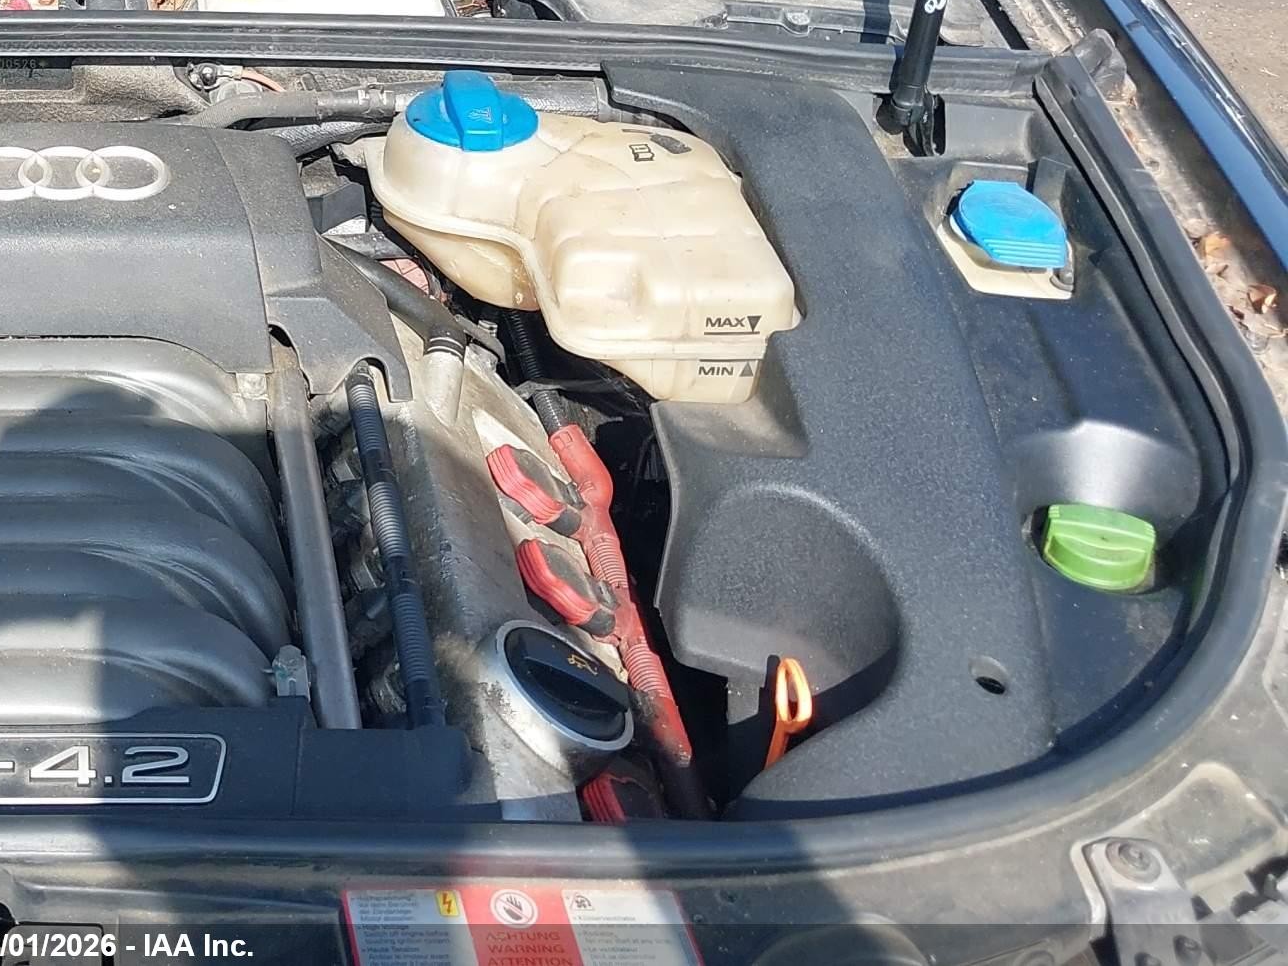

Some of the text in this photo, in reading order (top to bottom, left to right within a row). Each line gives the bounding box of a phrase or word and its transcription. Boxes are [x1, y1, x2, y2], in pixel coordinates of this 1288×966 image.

[705, 317, 745, 327] MAX
[698, 366, 733, 376] MIN
[486, 931, 560, 941] ACHTUNG
[488, 944, 565, 953] WARNING
[488, 957, 573, 966] ATTENTION
